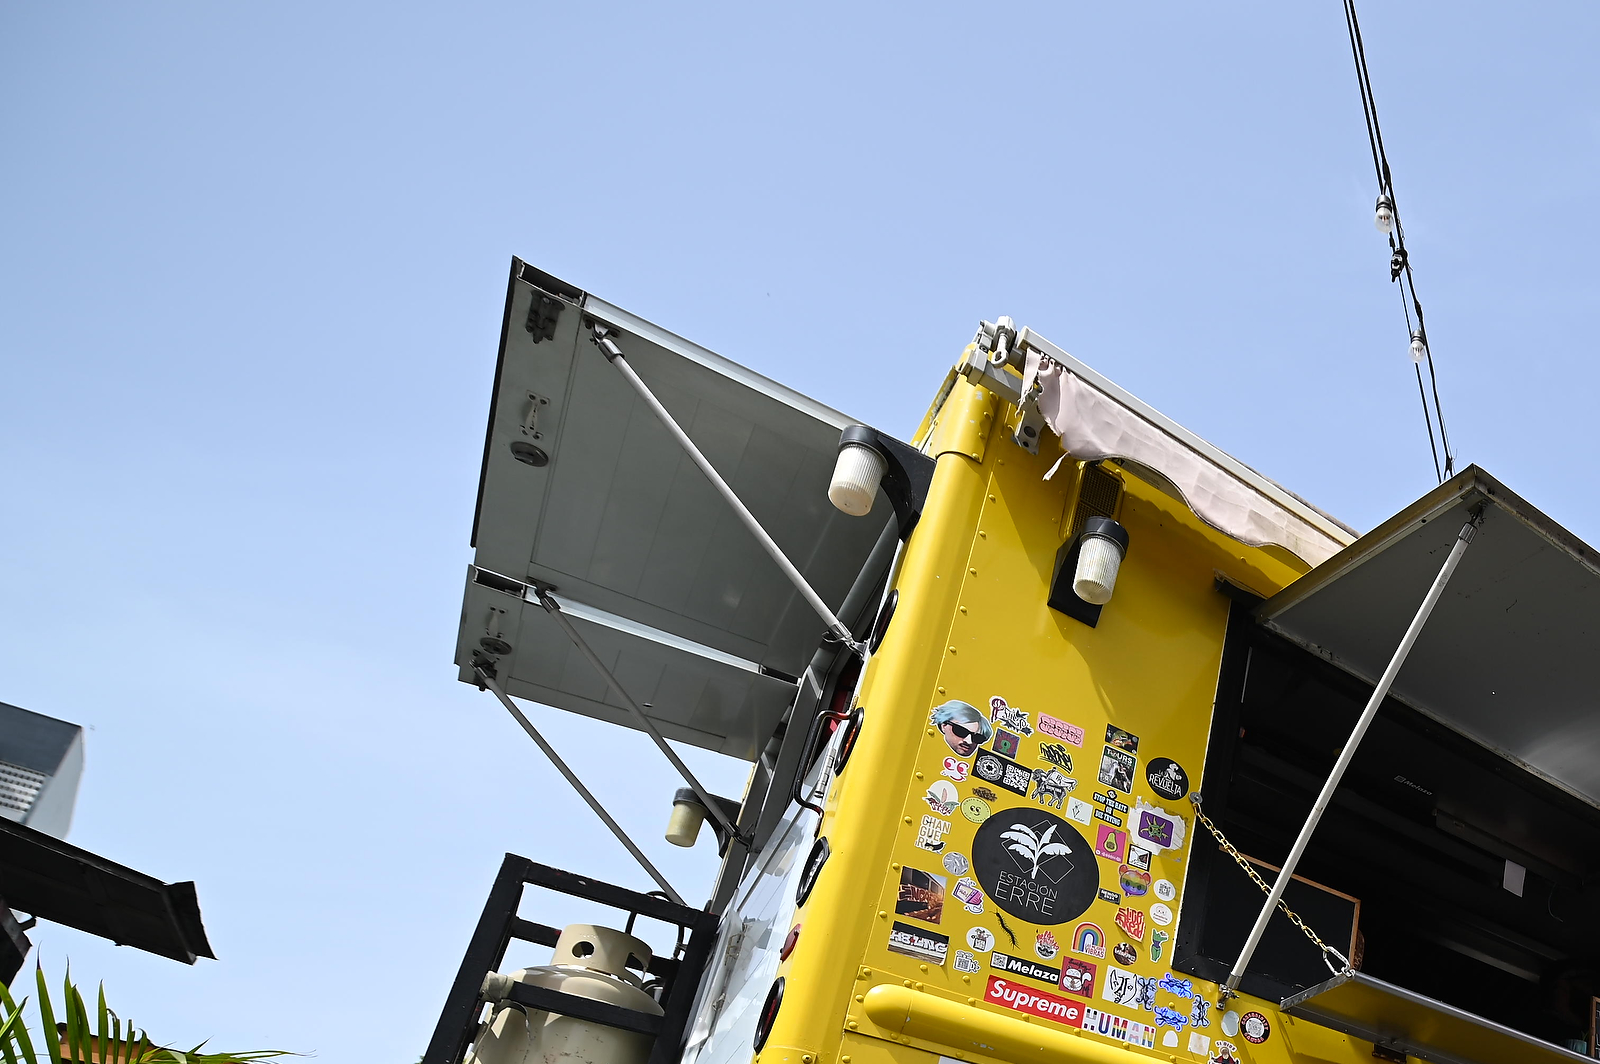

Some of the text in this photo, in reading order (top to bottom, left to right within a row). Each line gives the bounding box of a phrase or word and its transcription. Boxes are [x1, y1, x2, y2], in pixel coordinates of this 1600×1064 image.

[1148, 774, 1182, 797] REVUELTA
[920, 827, 940, 841] GUE
[922, 817, 950, 833] CHAN
[1000, 871, 1058, 899] ESTACIÓN
[995, 881, 1055, 916] ERRE
[1008, 959, 1059, 982] Melaza
[990, 980, 1079, 1020] Supreme
[1084, 1007, 1155, 1048] HUMAN
